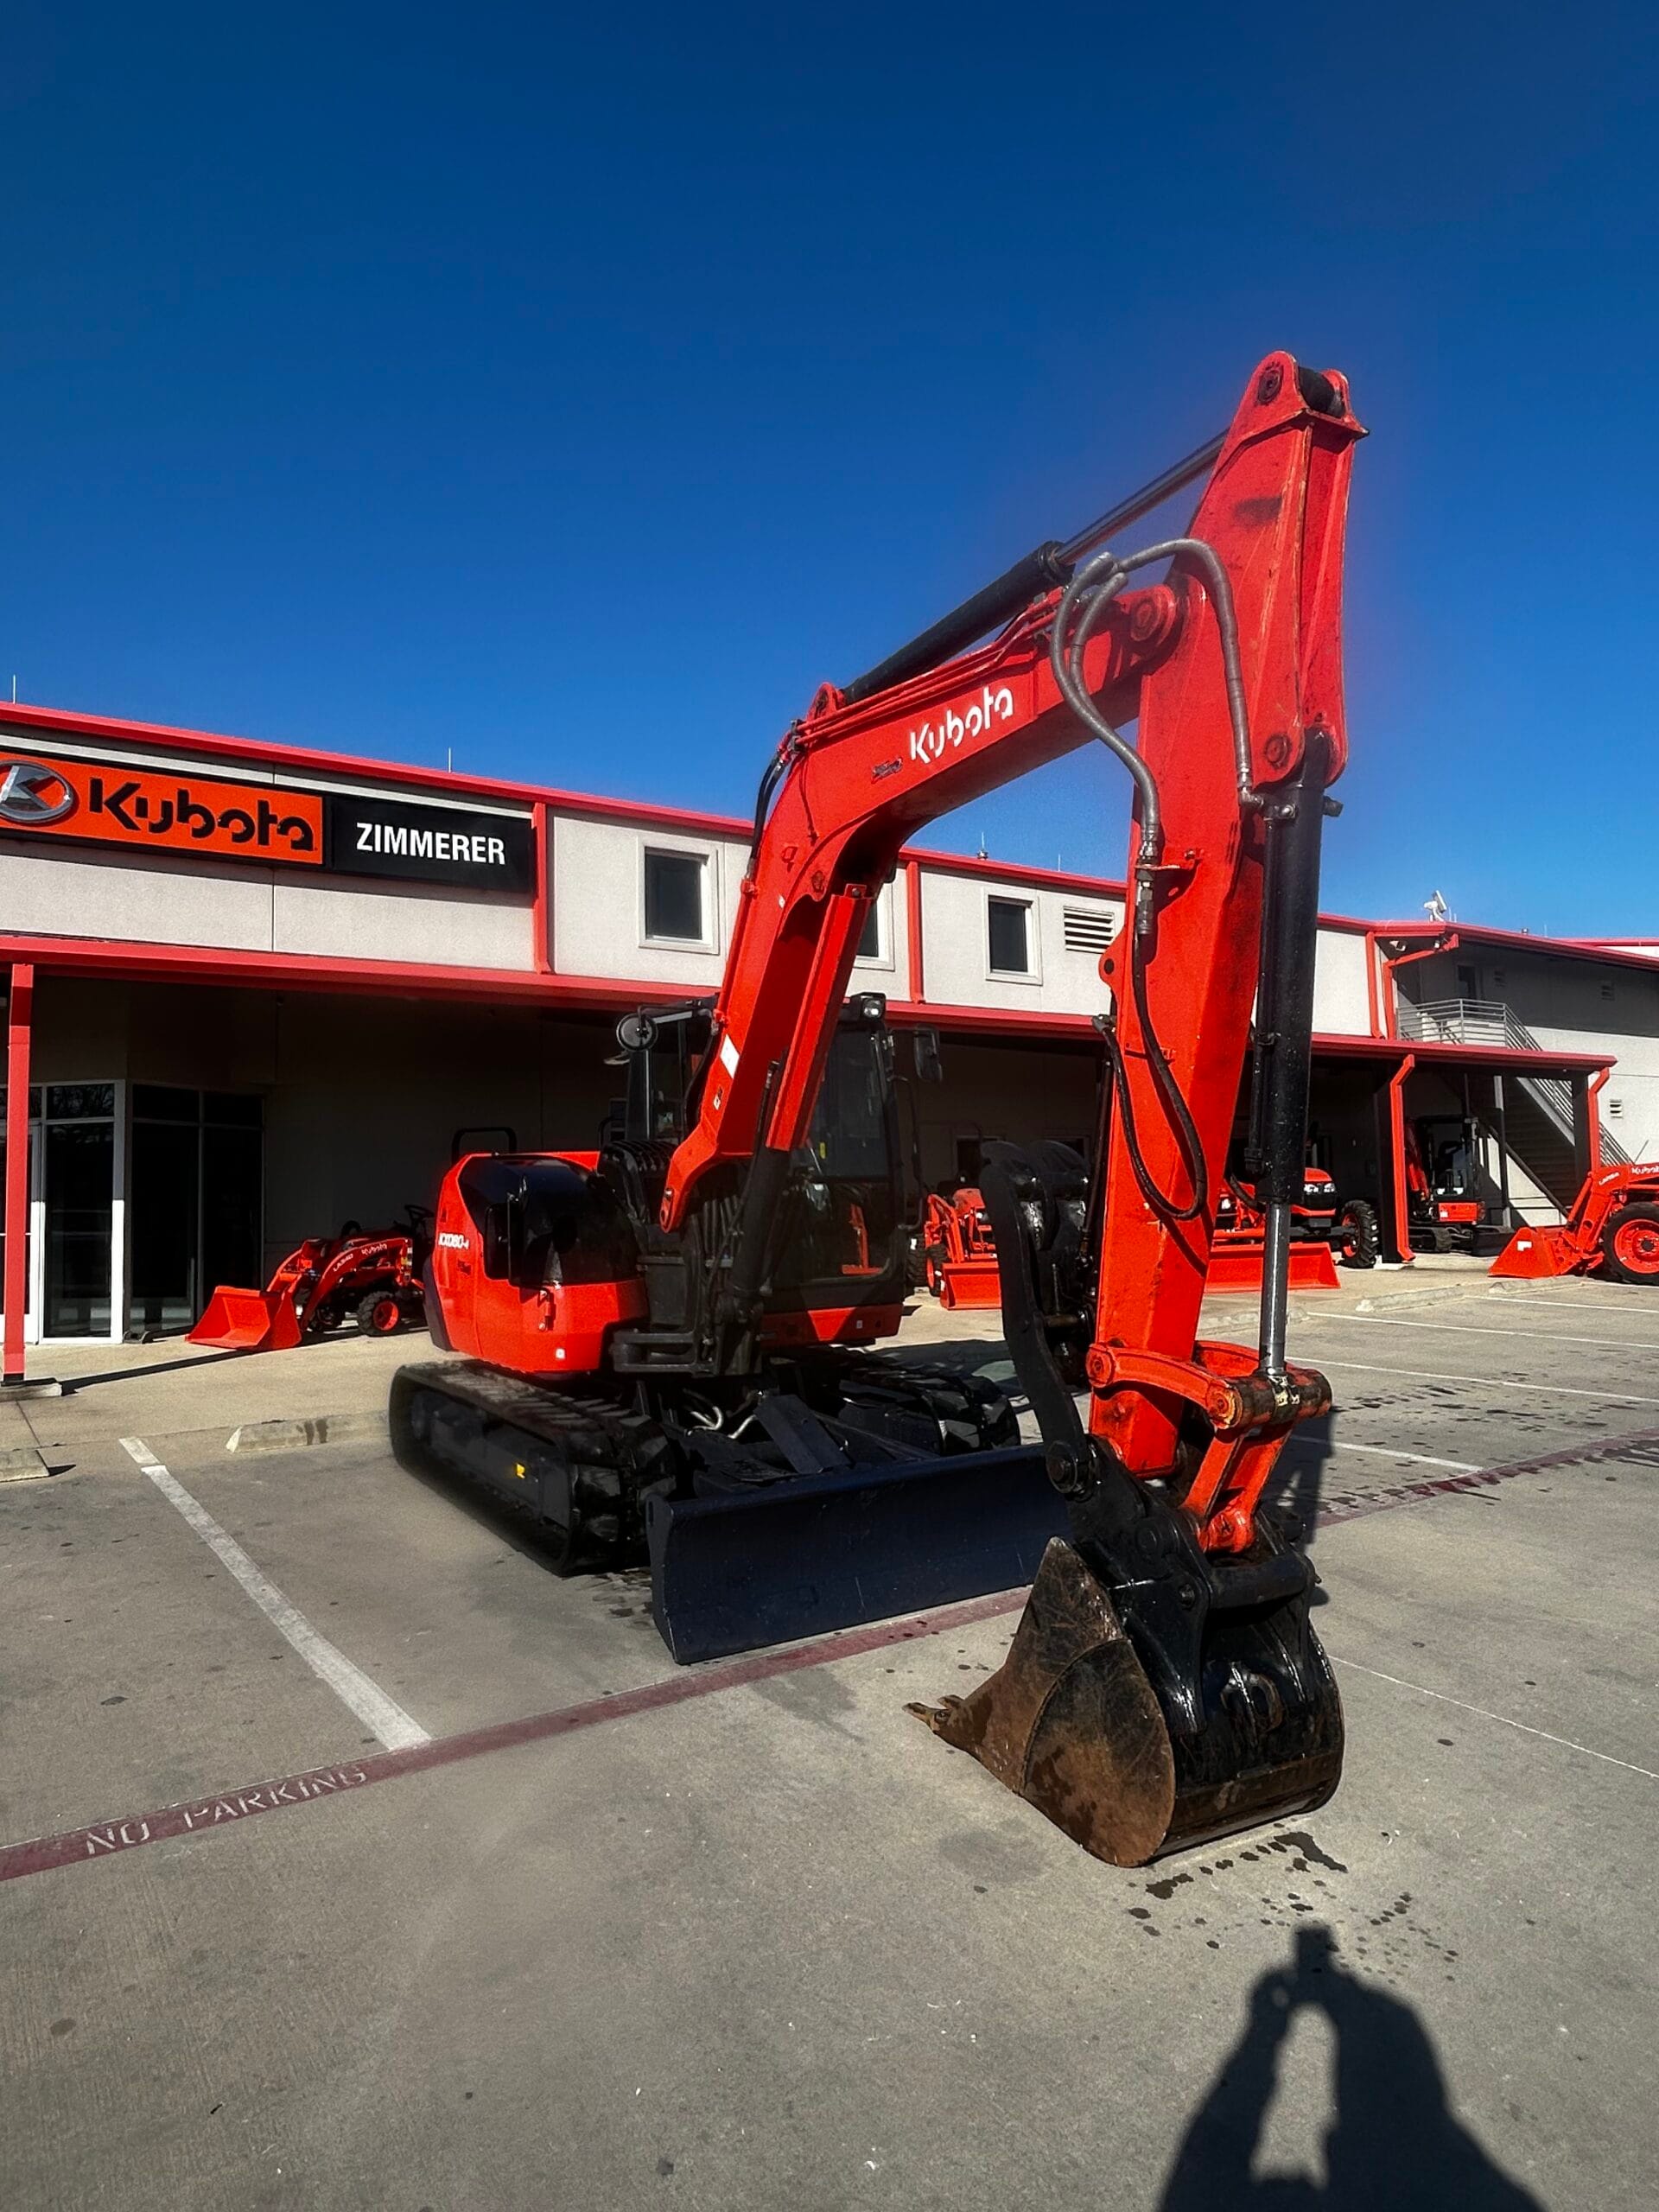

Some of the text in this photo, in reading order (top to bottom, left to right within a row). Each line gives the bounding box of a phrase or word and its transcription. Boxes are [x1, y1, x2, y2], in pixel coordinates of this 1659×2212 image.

[910, 686, 1014, 764] Kubota
[89, 777, 315, 851] Kubota
[356, 822, 506, 865] ZIMMERER
[361, 1243, 387, 1255] Kubota
[86, 1767, 367, 1855] NO PARKING
